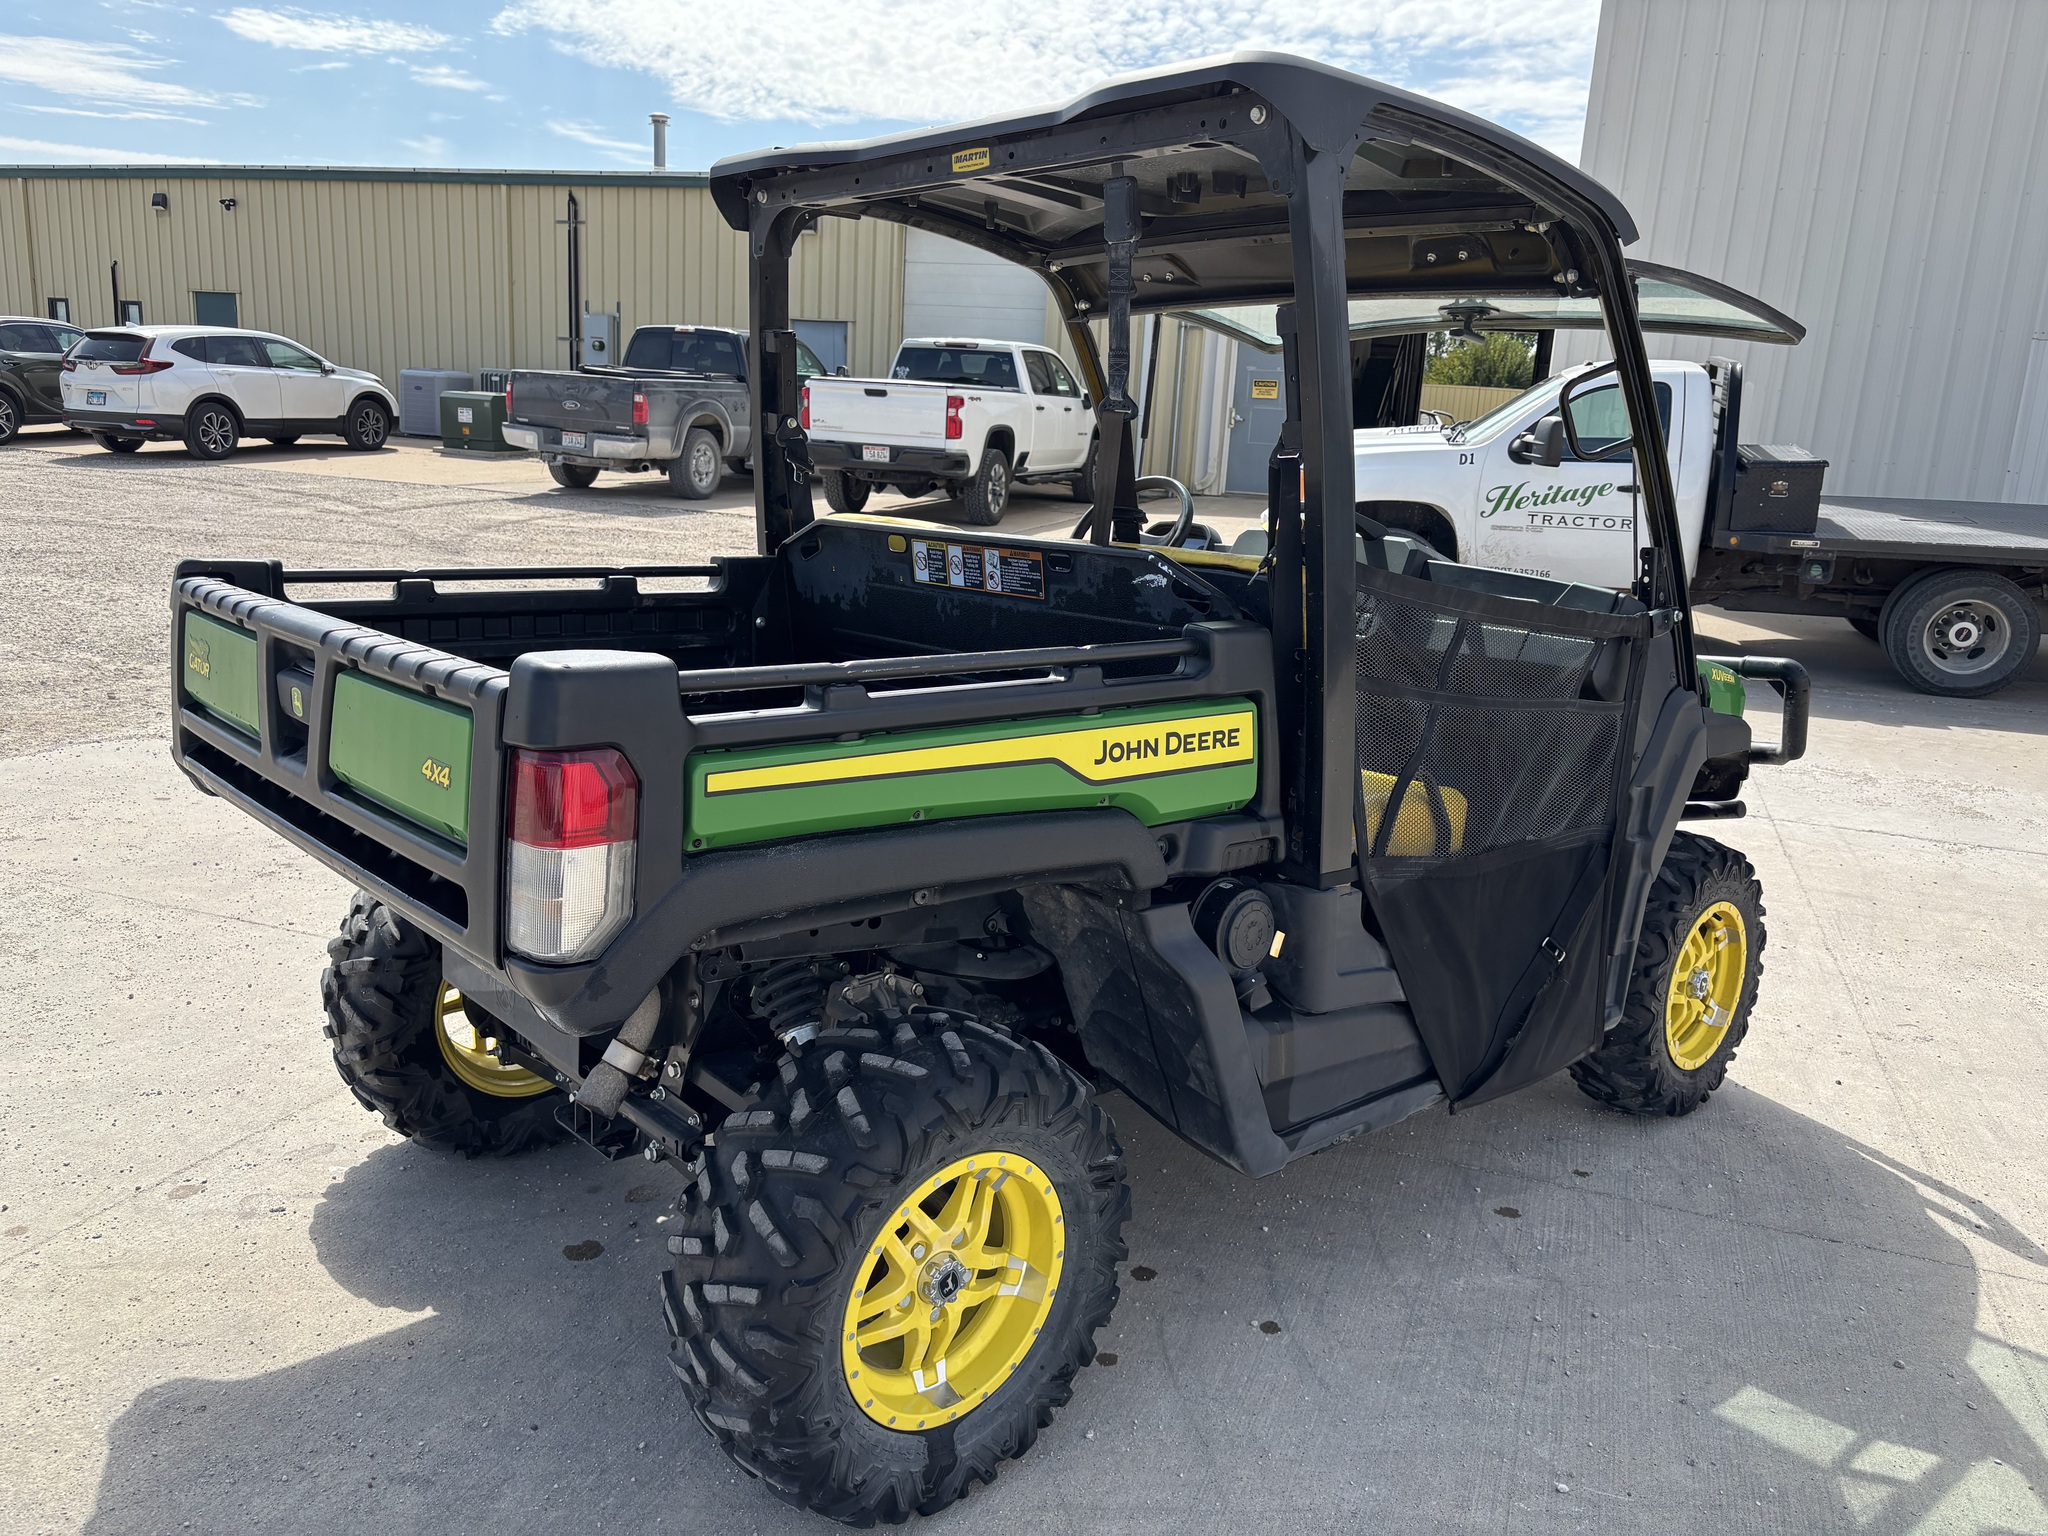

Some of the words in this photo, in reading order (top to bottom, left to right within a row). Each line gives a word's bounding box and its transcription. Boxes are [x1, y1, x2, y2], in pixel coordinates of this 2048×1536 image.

[954, 150, 988, 164] MARTIN
[1459, 453, 1475, 465] D1
[1480, 481, 1616, 518] Heritage
[1527, 513, 1633, 530] TRACTOR
[189, 652, 210, 678] GATOR
[1094, 738, 1159, 765] JOHN
[1165, 728, 1240, 756] DEERE
